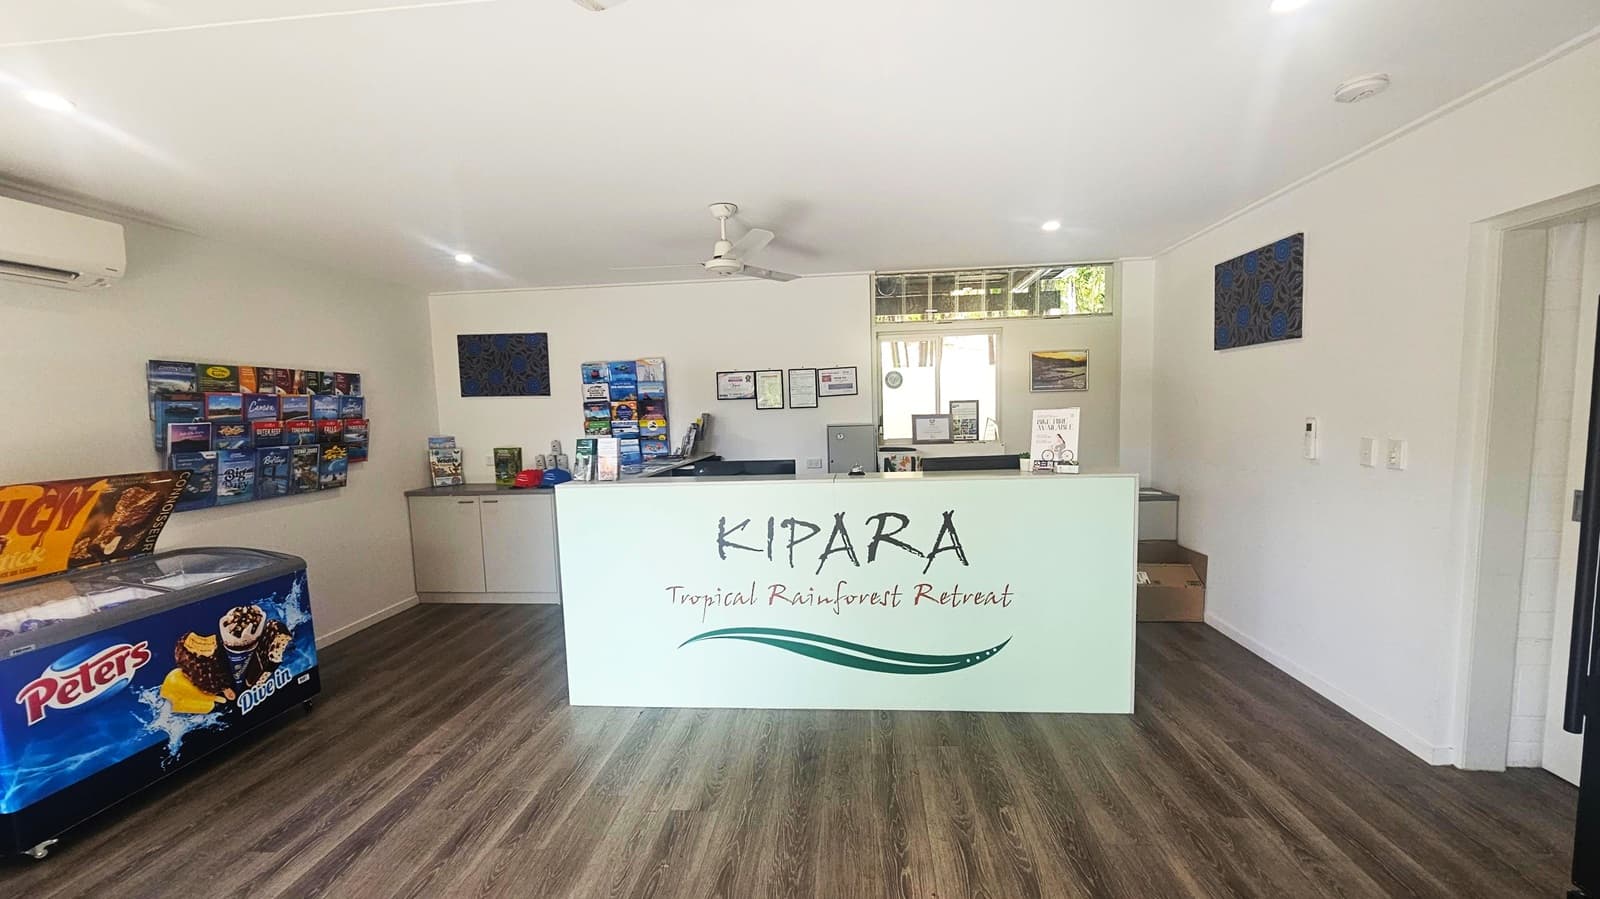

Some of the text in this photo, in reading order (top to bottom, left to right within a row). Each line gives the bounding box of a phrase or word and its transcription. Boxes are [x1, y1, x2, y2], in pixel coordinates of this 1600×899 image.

[224, 467, 247, 481] Big
[142, 471, 191, 552] CONNOISSEUR
[716, 510, 969, 575] KIPARA
[665, 580, 1014, 623] Tropical Rainforest Retreat
[17, 641, 151, 726] Peters
[237, 668, 292, 715] Dive in
